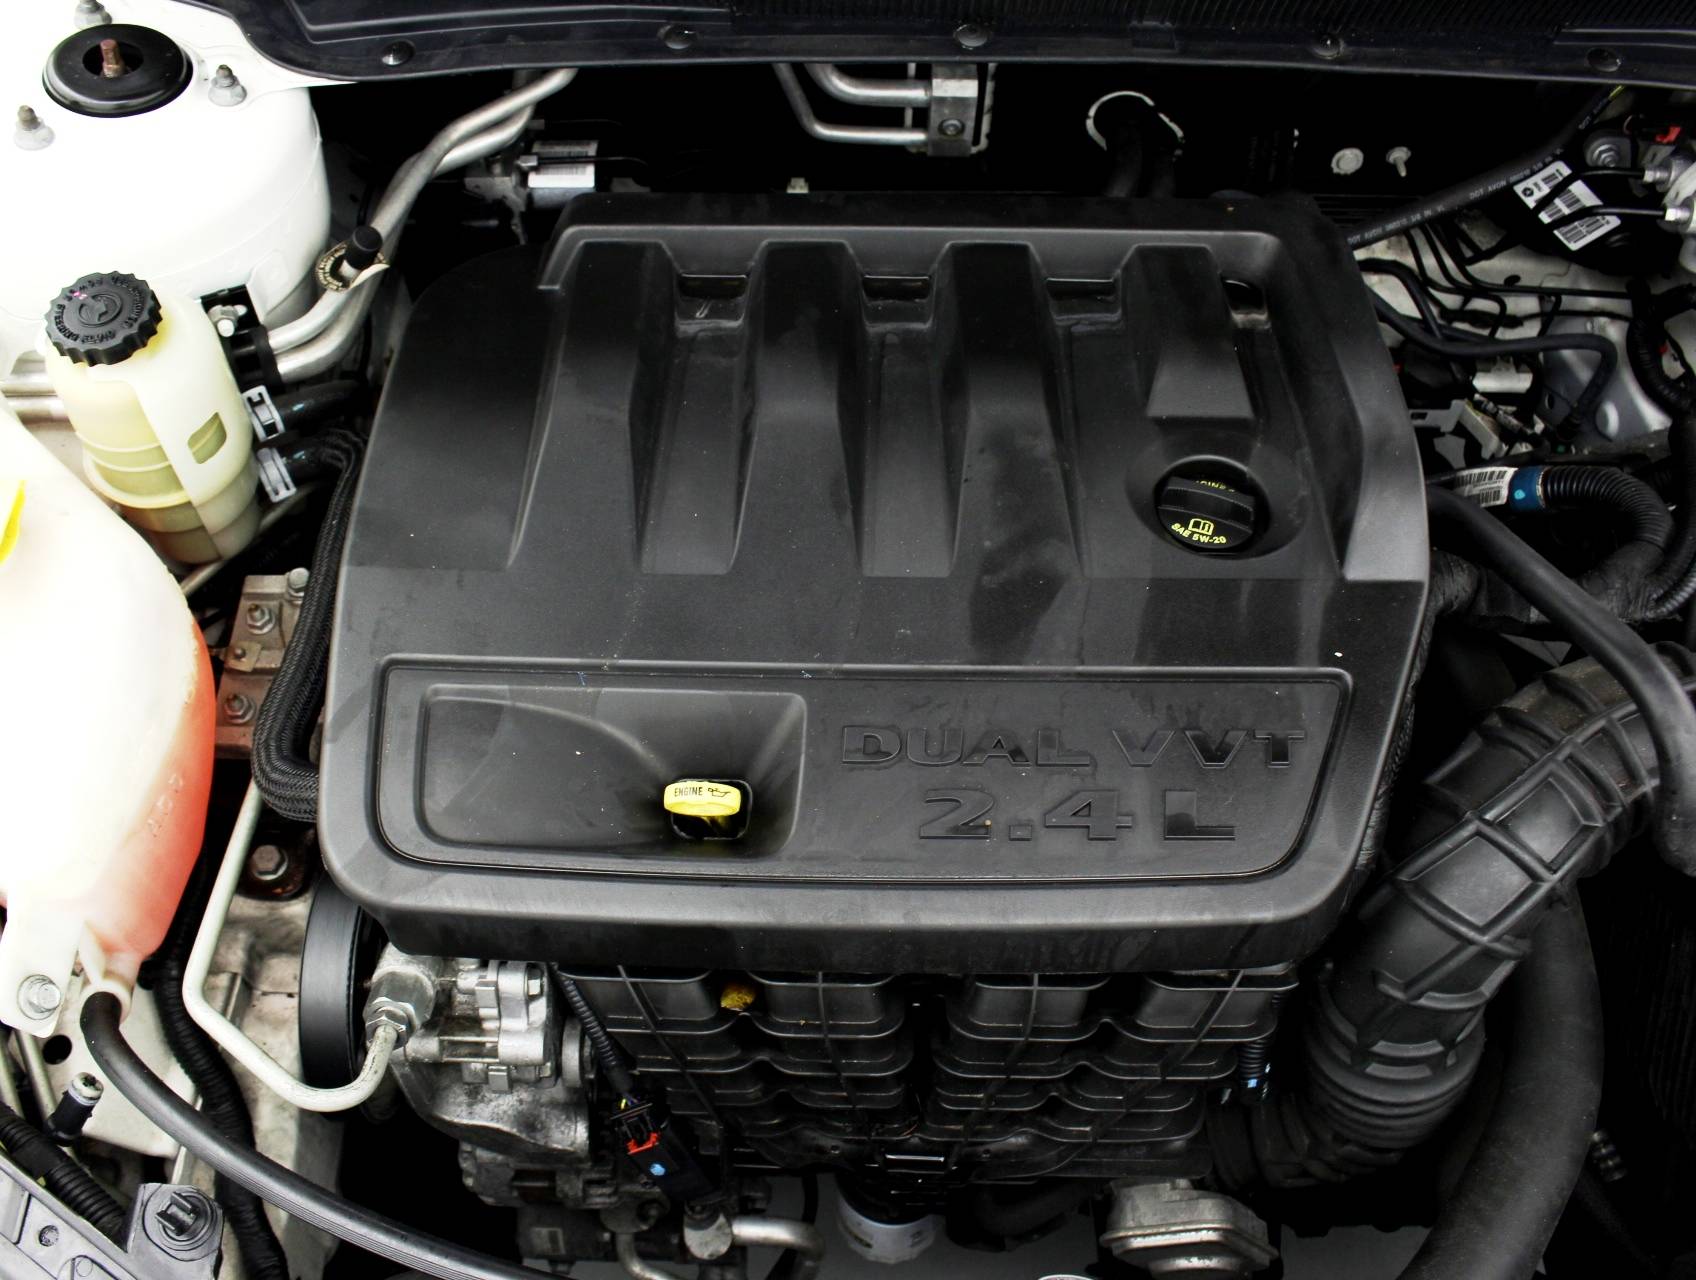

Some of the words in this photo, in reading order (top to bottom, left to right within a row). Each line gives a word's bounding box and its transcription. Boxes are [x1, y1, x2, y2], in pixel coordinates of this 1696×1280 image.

[1469, 188, 1484, 200] DOT
[1171, 522, 1192, 538] SAE
[1192, 533, 1227, 544] 5W-20
[841, 725, 1092, 768] DUAL
[1112, 728, 1306, 769] VVT
[674, 786, 703, 798] ENGINE
